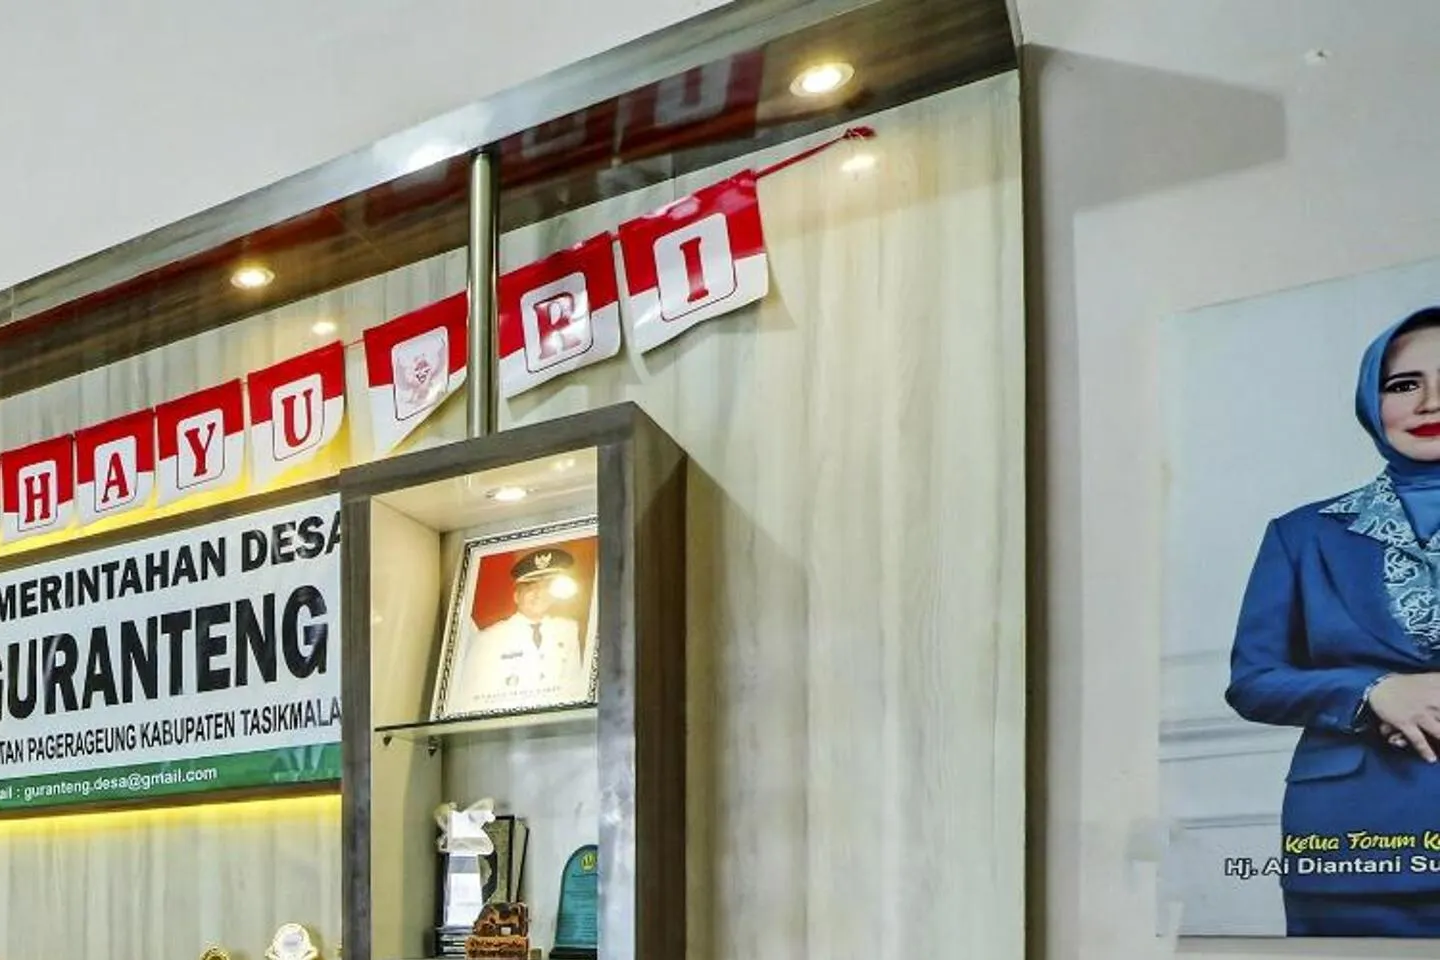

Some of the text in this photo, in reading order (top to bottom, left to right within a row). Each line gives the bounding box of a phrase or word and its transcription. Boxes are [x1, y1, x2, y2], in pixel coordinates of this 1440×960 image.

[537, 236, 707, 361] RI
[241, 510, 341, 573] DESA
[28, 724, 137, 762] PAGERAGEUNG
[140, 711, 235, 748] KABUPATEN
[24, 767, 218, 800] guranteng.desa@gmail.com
[1285, 834, 1340, 854] Ketua
[1346, 831, 1416, 850] Forum
[1225, 855, 1440, 878] Hj. Ai Diantani Su
